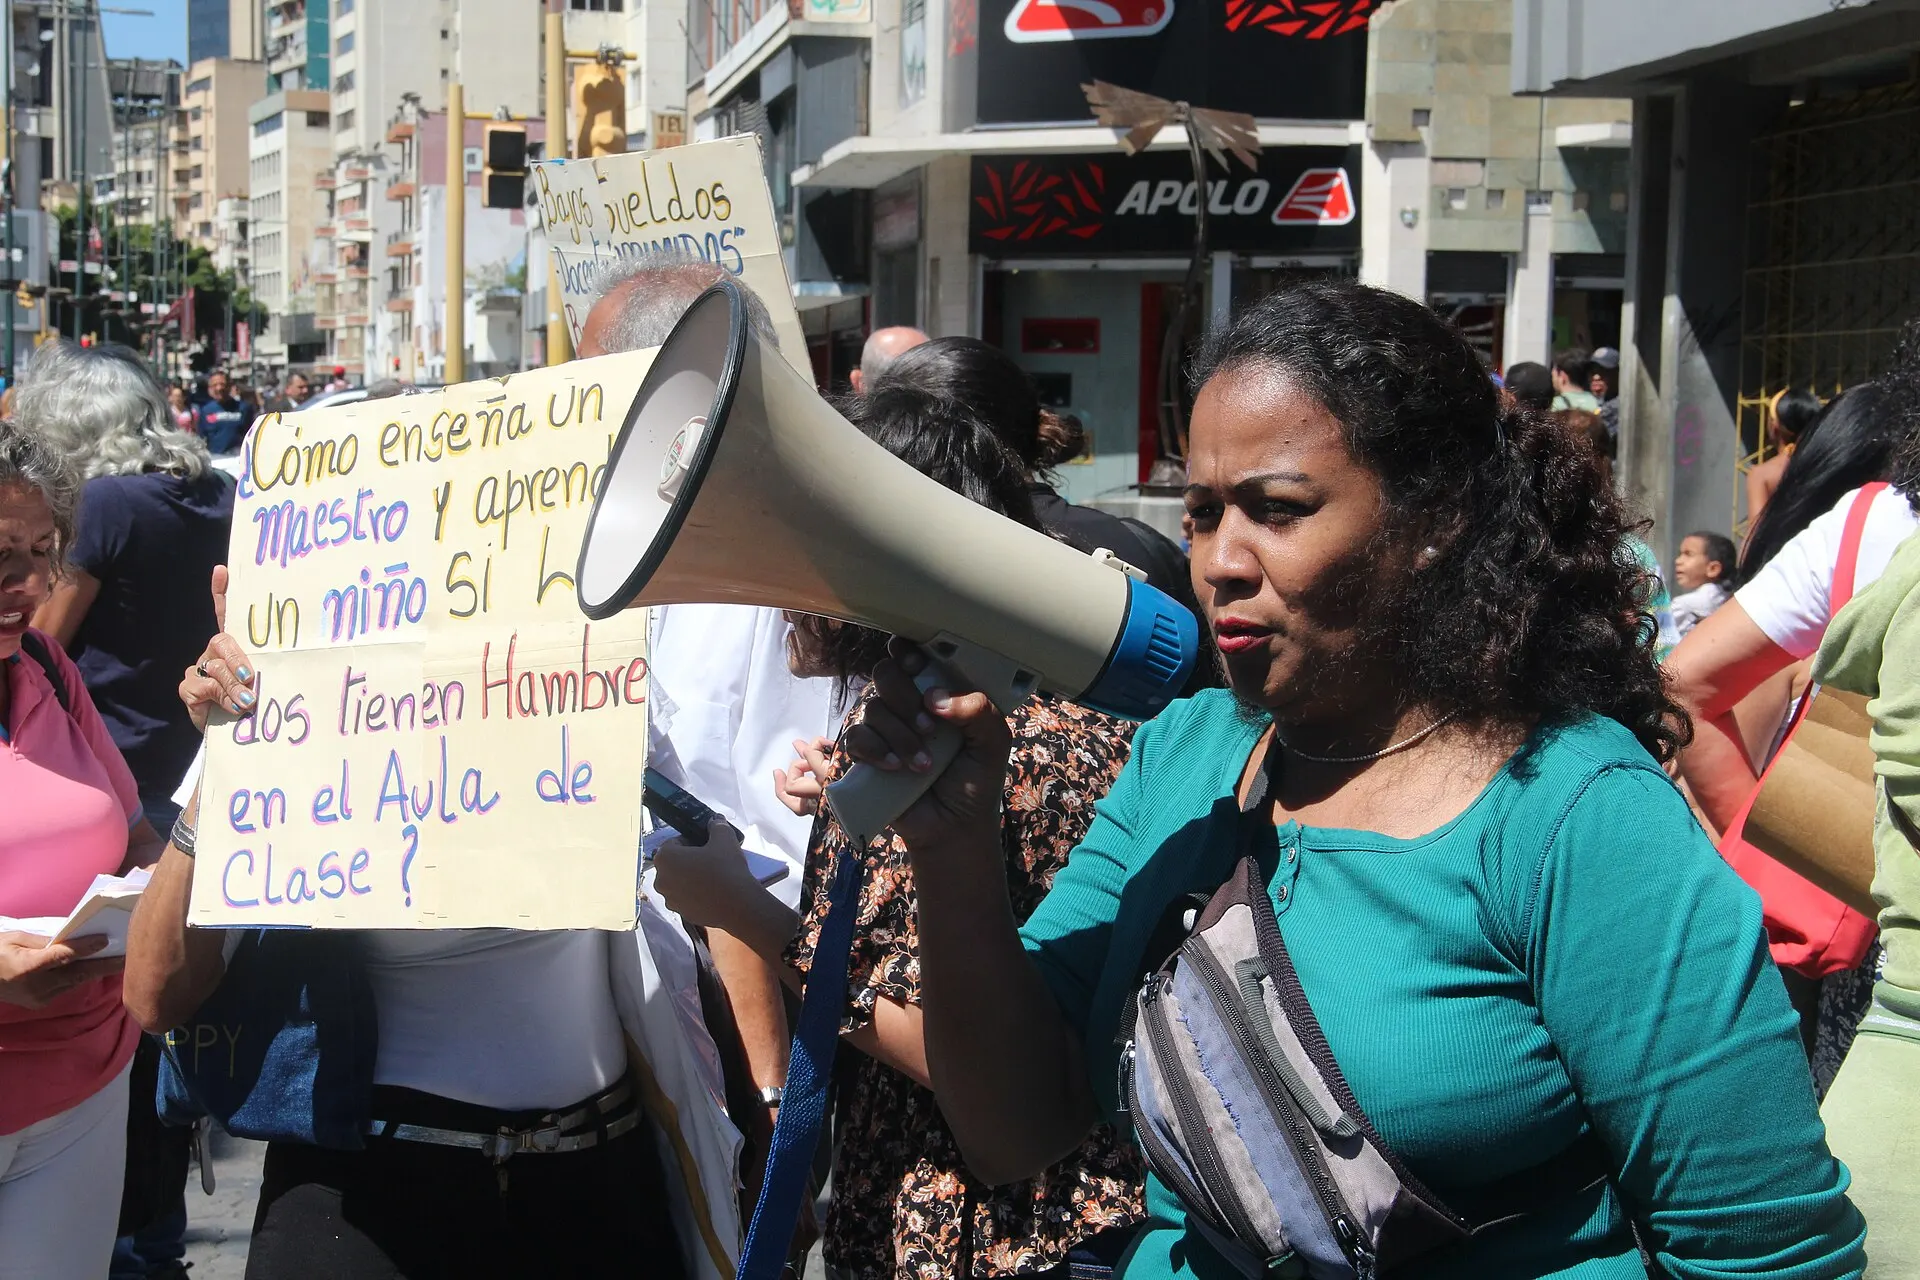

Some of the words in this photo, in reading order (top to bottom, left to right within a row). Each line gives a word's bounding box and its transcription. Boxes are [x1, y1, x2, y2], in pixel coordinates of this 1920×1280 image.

[1115, 178, 1271, 217] APOLO
[379, 394, 536, 468] enseña
[248, 592, 300, 648] un
[324, 562, 428, 643] niño
[232, 671, 311, 746] dos
[481, 624, 648, 721] Hambre
[229, 788, 287, 834] en
[311, 758, 353, 826] el
[374, 734, 500, 826] Aula
[535, 723, 598, 805] de
